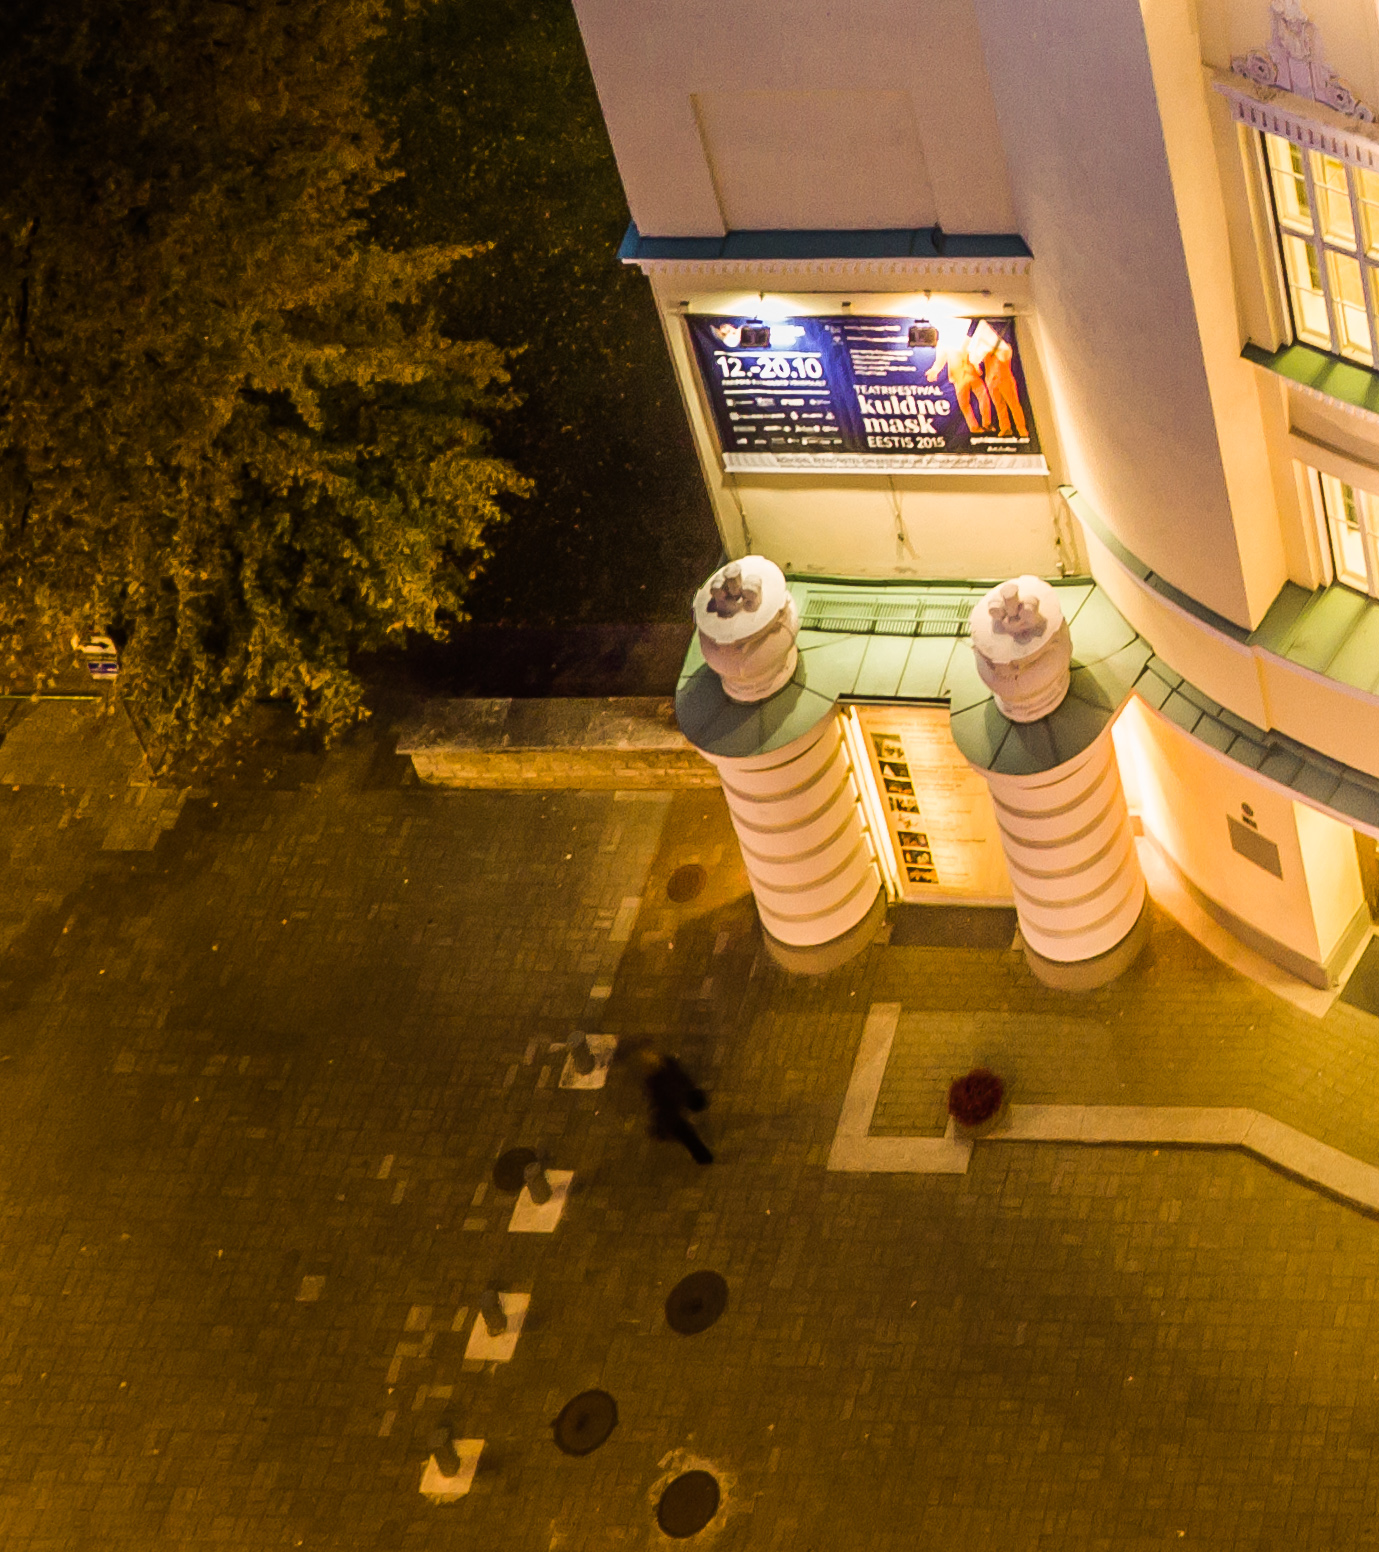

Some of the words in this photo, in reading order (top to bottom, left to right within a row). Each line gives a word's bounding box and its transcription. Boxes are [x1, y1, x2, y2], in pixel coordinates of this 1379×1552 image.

[853, 384, 943, 396] TEATRIFESTIVAL
[857, 394, 950, 415] kuldne
[863, 414, 937, 434] mask
[867, 435, 914, 448] EESTIS
[917, 435, 945, 449] 2015
